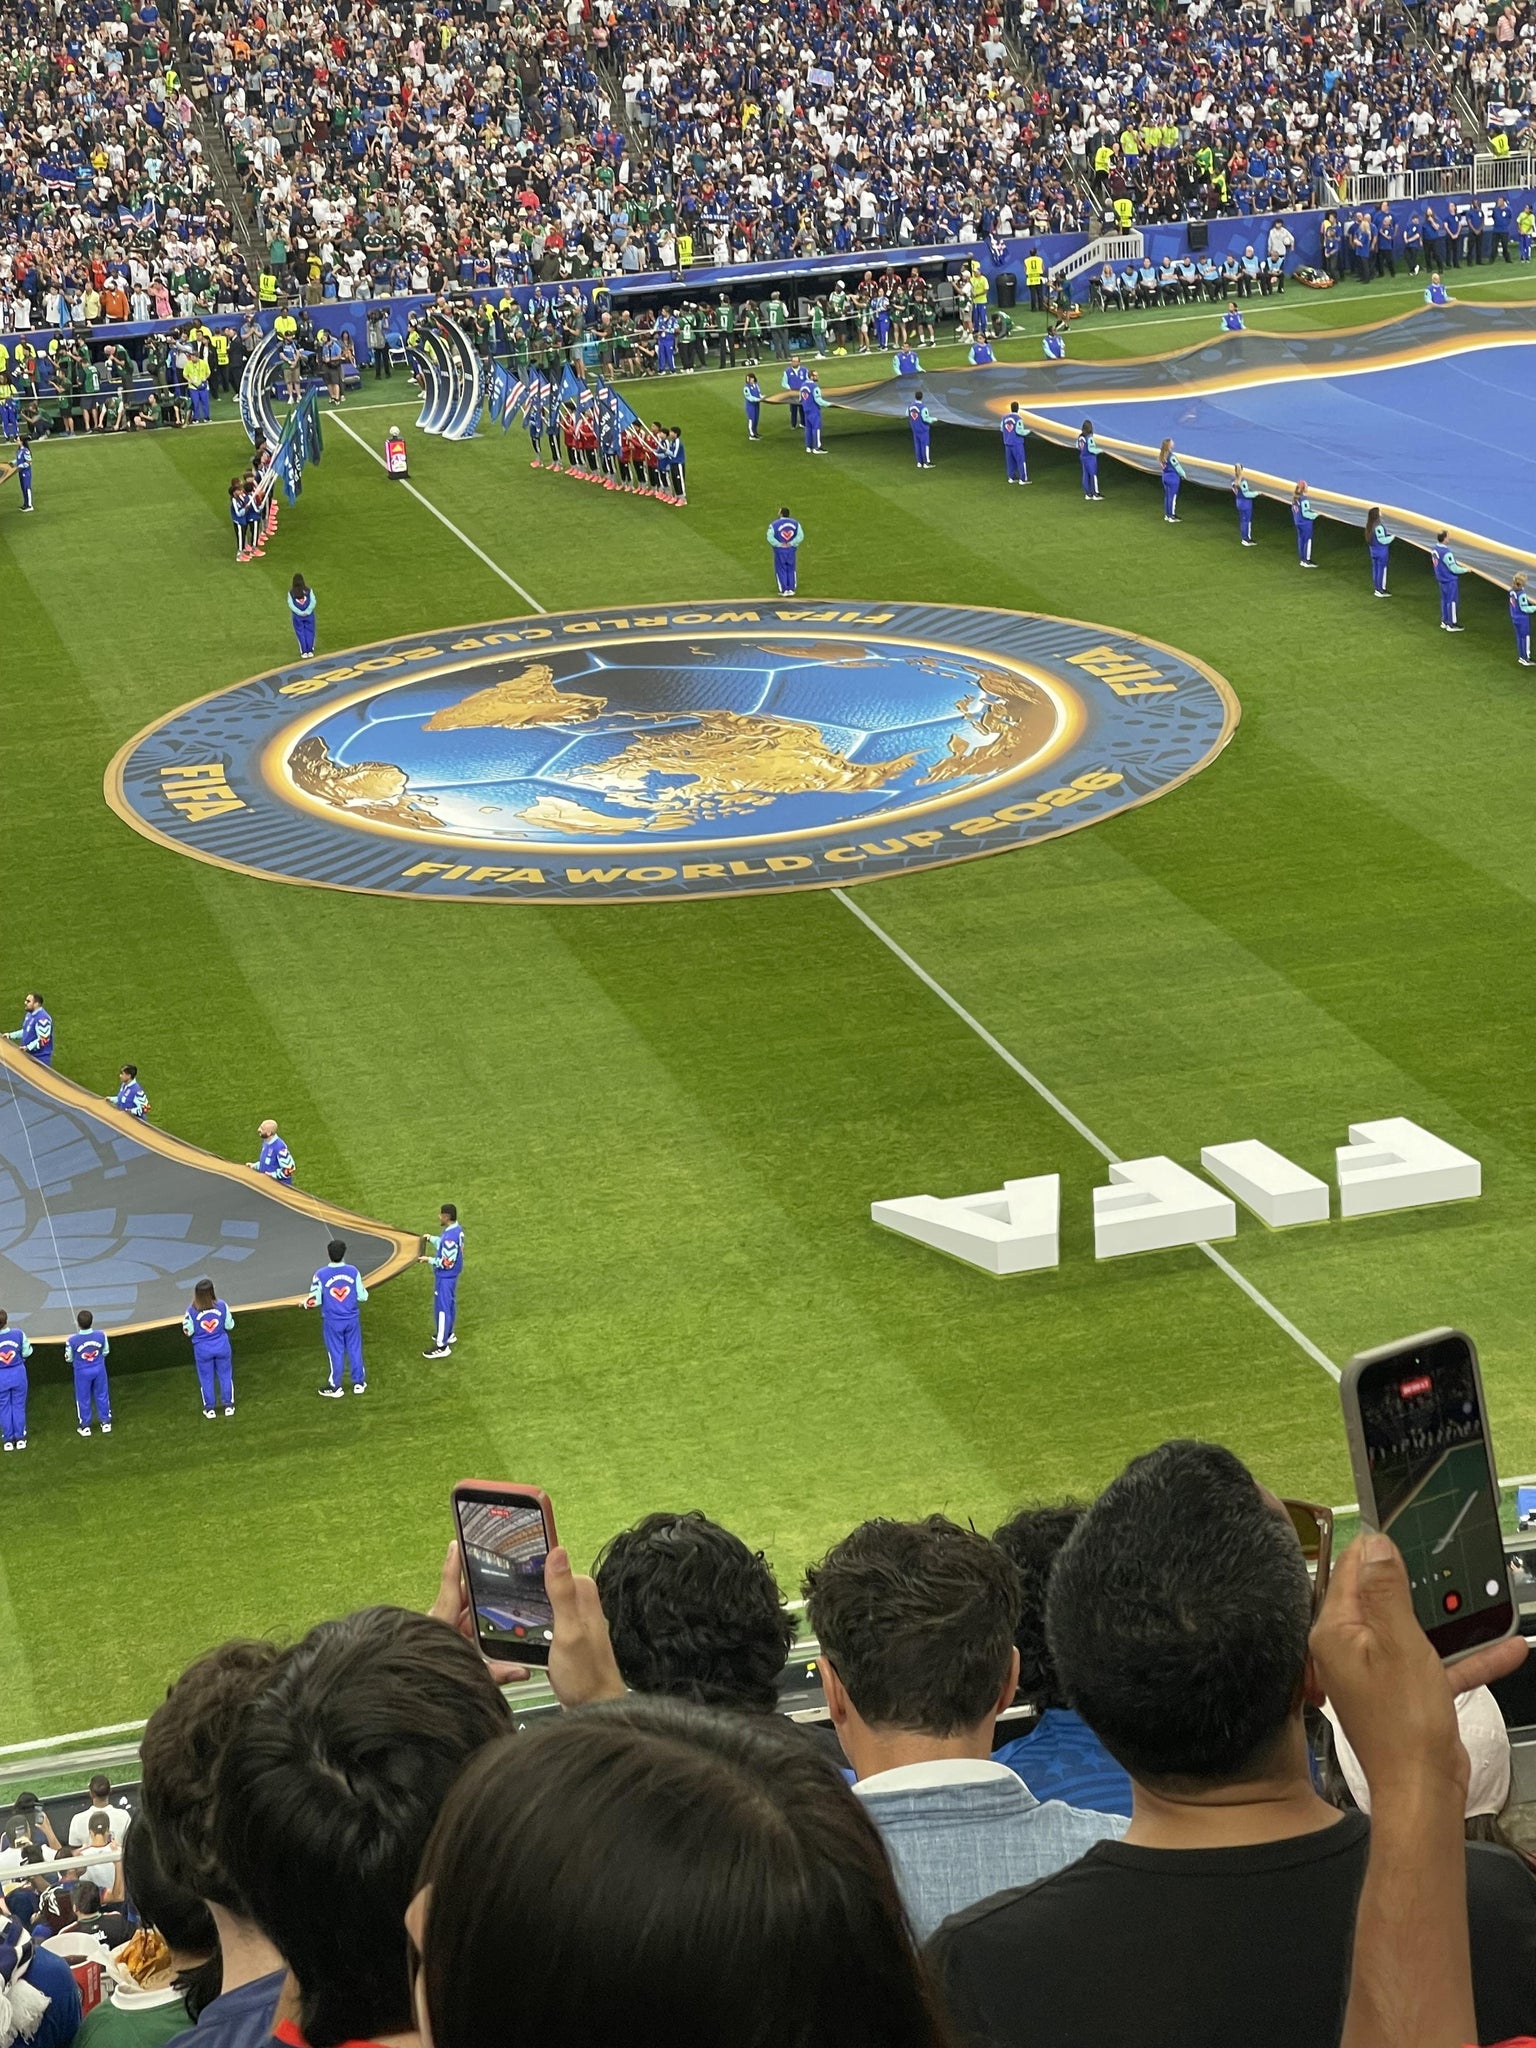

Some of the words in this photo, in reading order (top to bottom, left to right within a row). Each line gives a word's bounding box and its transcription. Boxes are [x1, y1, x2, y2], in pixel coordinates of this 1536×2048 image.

[451, 628, 552, 650] CUP
[563, 611, 760, 633] WORLD
[775, 610, 896, 624] FIFA
[278, 646, 444, 696] 2026
[1065, 645, 1178, 696] FIFA
[160, 763, 247, 823] FIFA
[401, 860, 546, 884] FIFA
[565, 855, 813, 884] WORLD
[823, 830, 944, 863] CUP
[950, 771, 1124, 837] 2026
[871, 1116, 1482, 1275] FIFA
